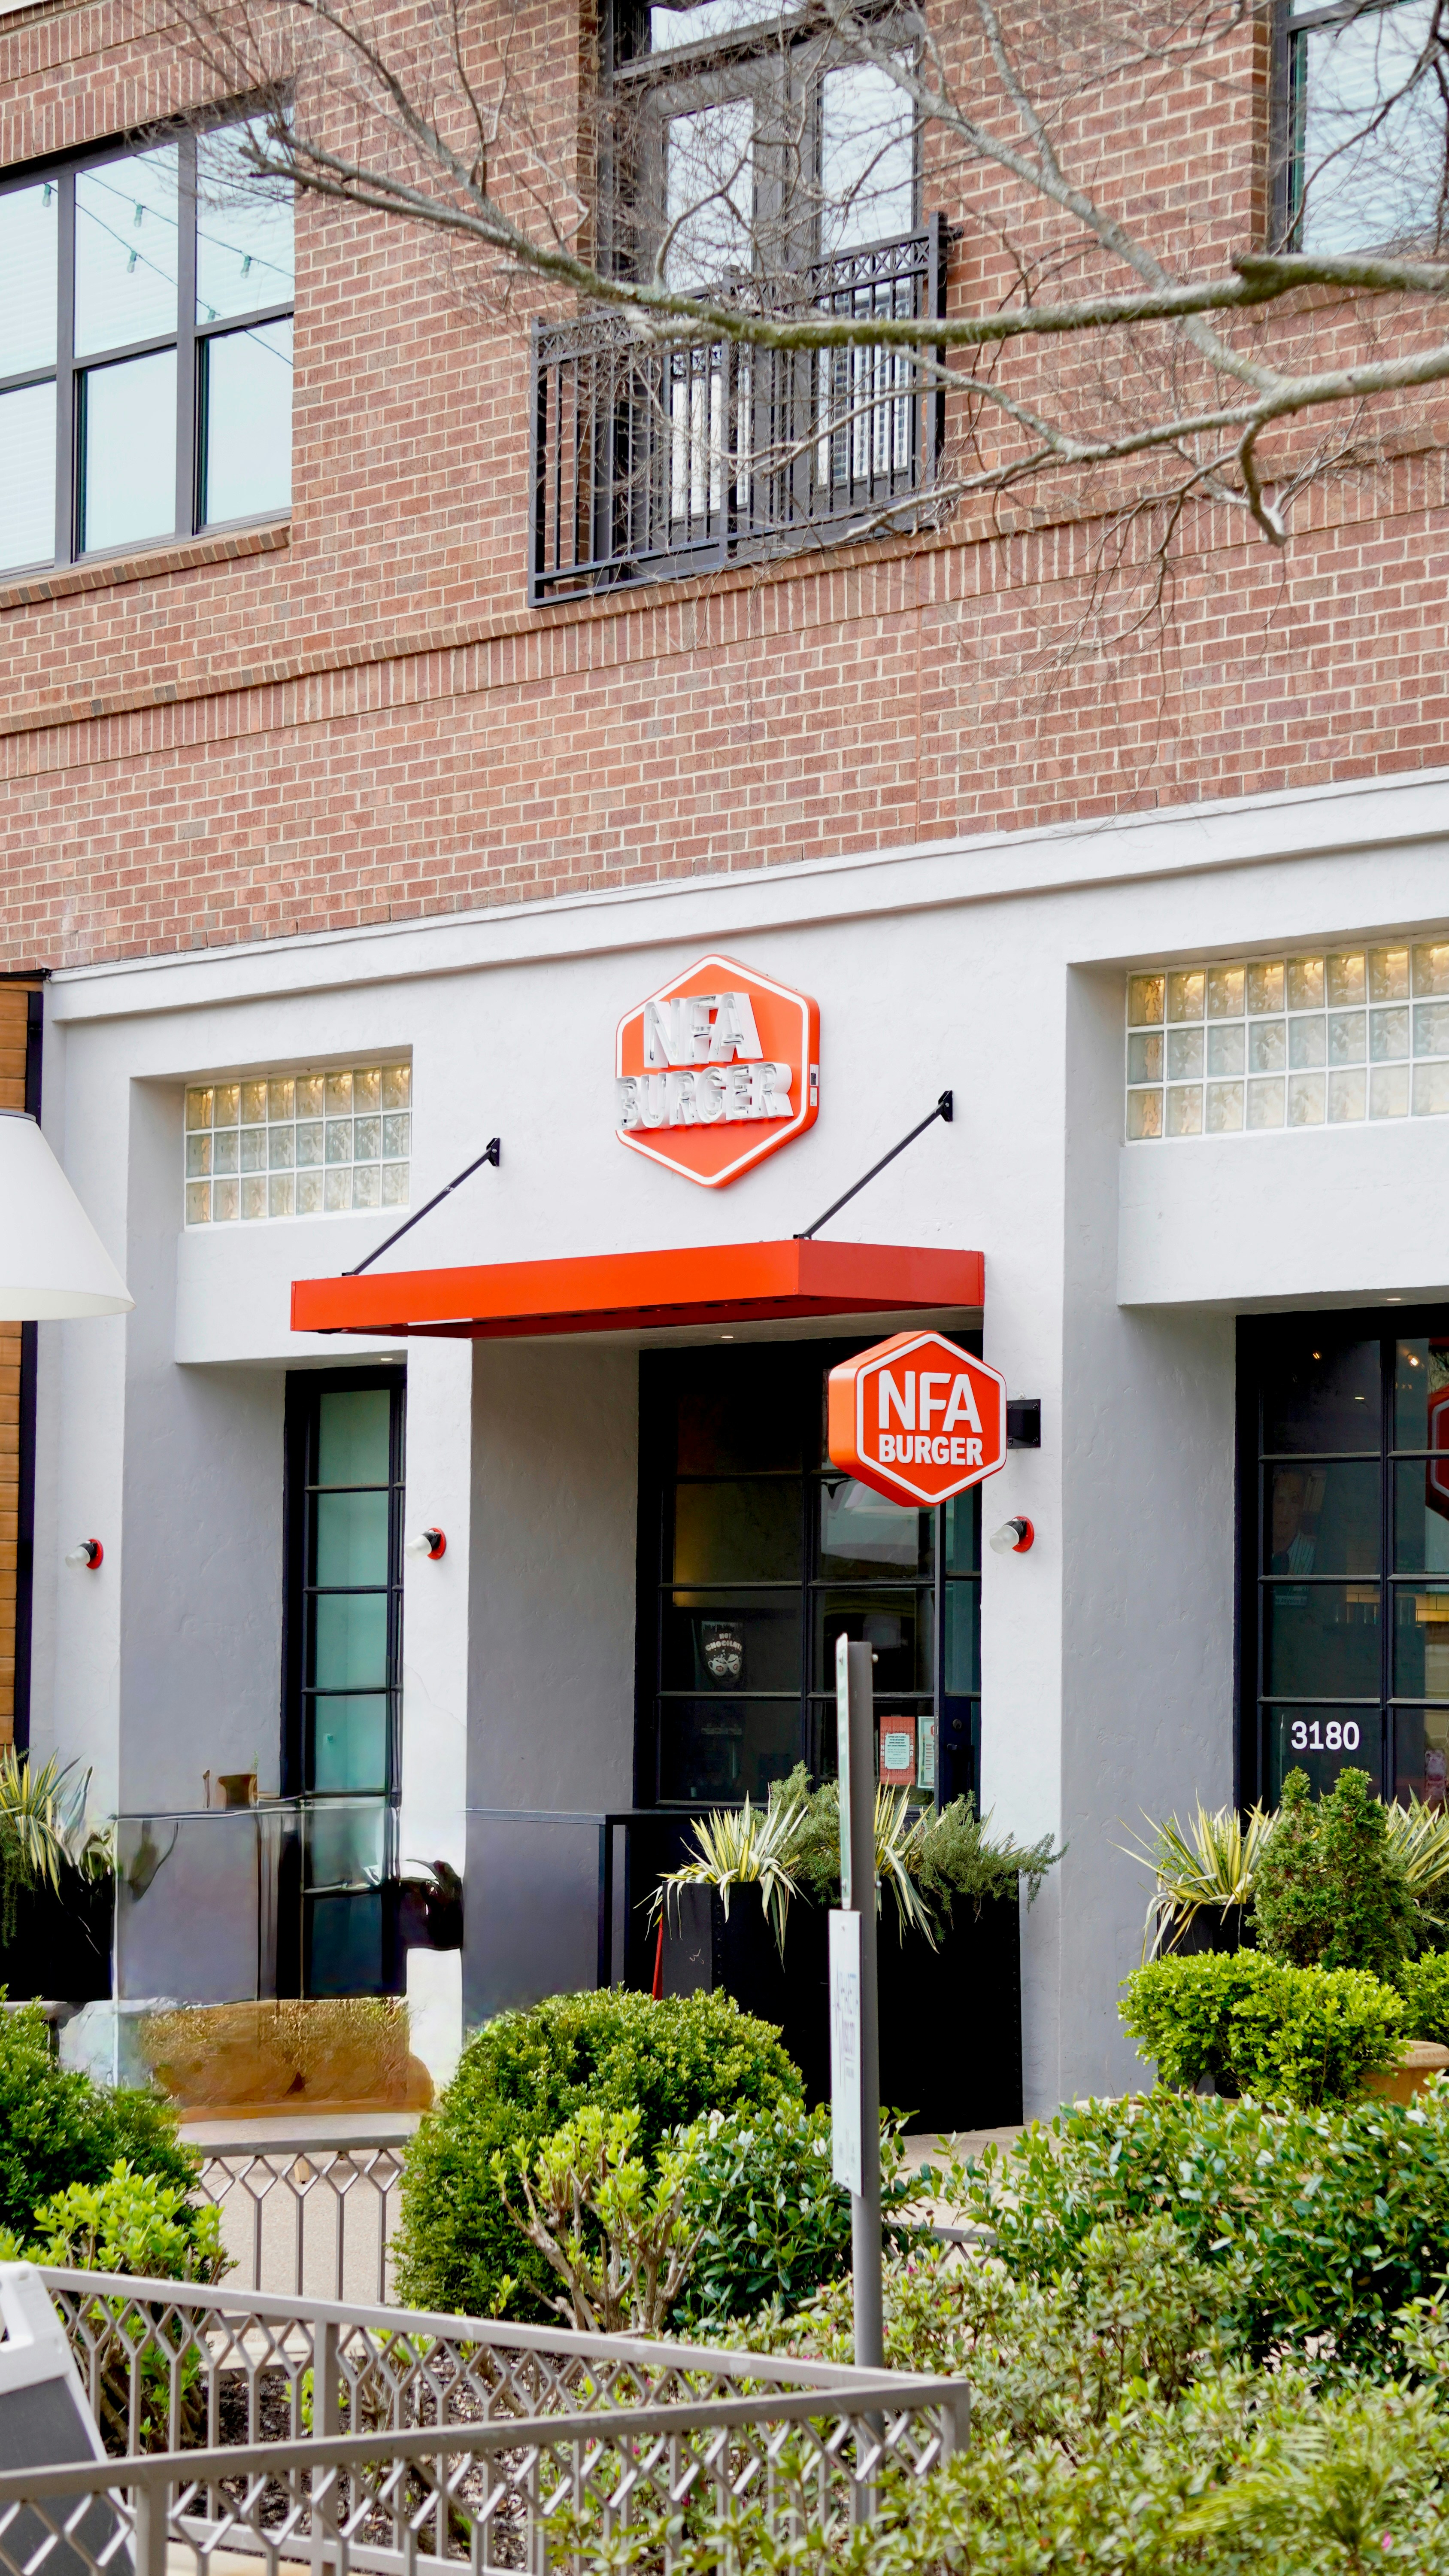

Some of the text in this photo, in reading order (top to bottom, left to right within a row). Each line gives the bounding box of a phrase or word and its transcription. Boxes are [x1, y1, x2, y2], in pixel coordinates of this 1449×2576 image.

[644, 992, 764, 1068] NFA
[615, 1062, 794, 1131] BURGER
[879, 1370, 983, 1433] NFA
[879, 1434, 983, 1466] BURGER
[1291, 1721, 1359, 1750] 3180
